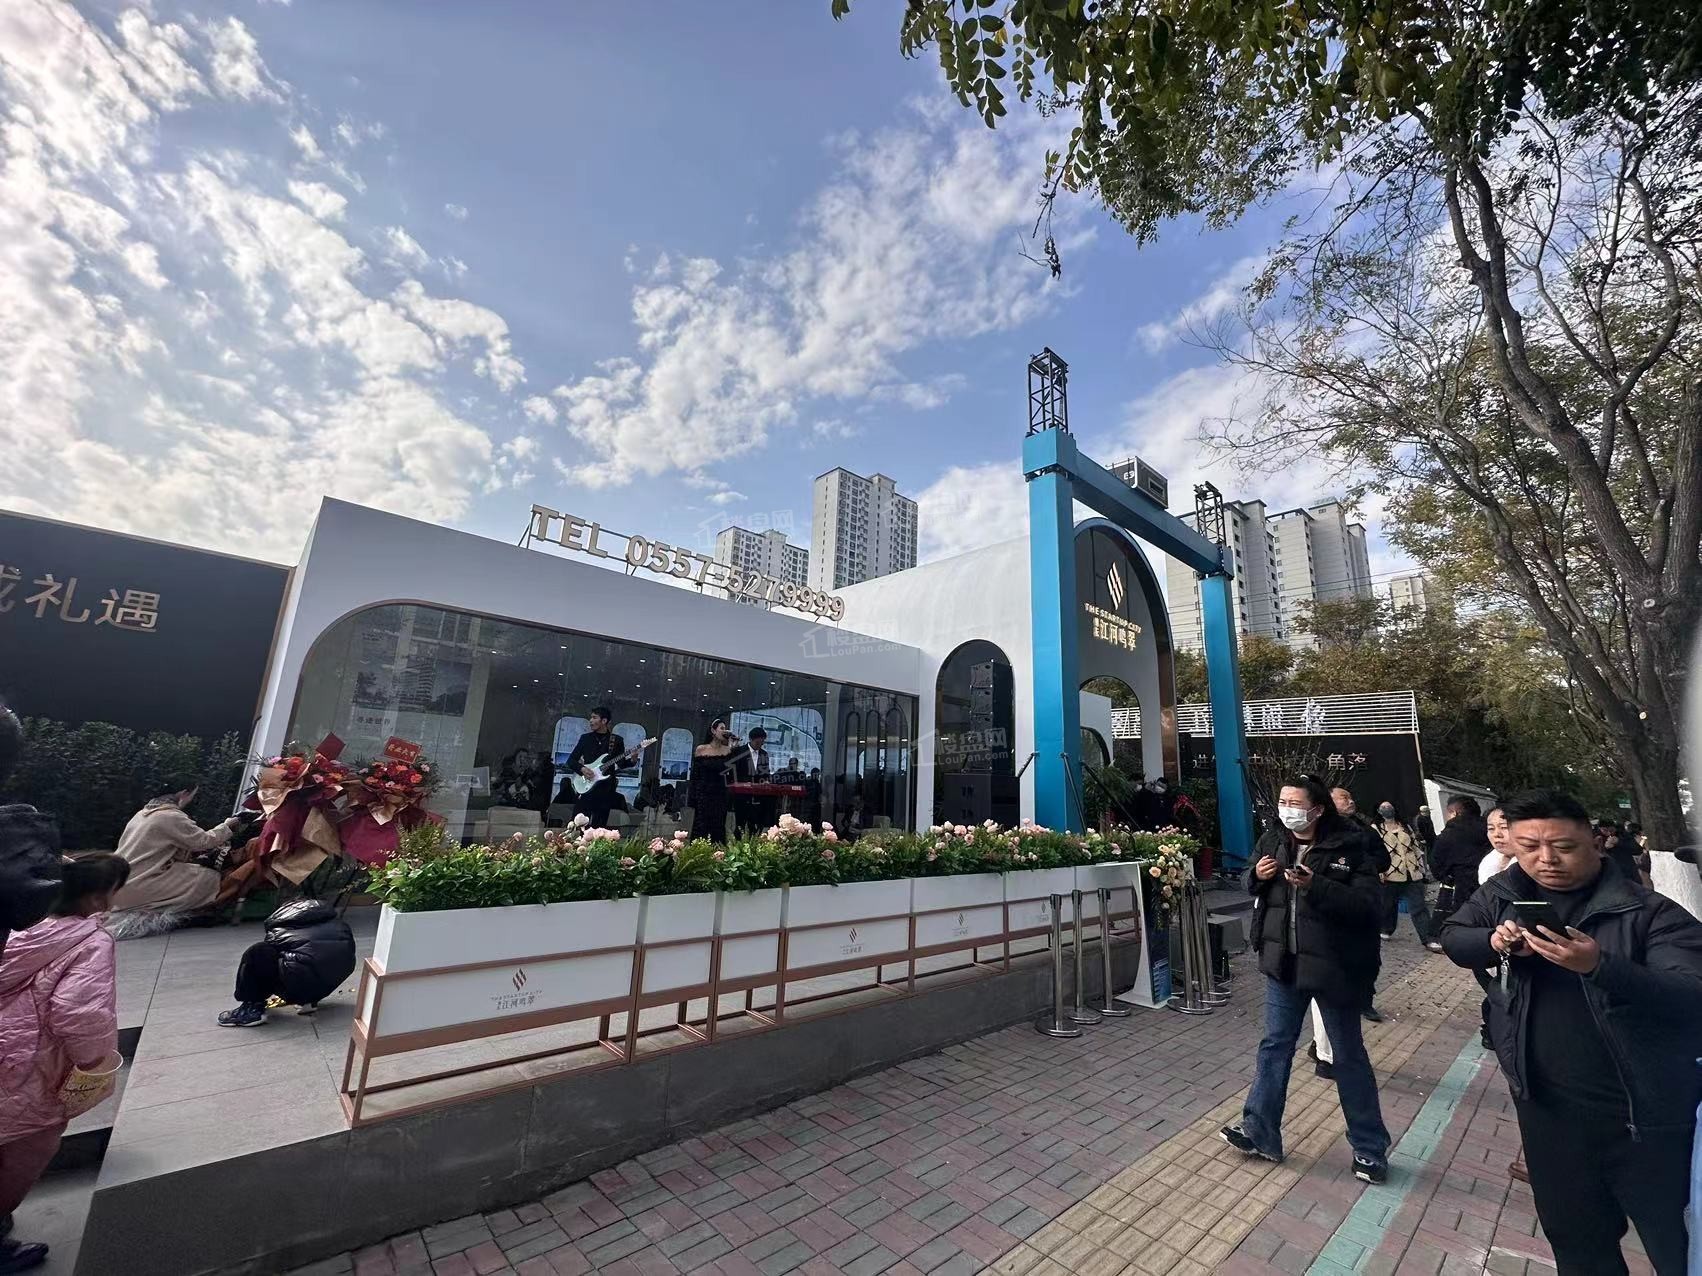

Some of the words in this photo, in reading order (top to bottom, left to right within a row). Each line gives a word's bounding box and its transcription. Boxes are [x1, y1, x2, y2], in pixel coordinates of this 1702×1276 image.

[531, 504, 608, 558] TEL
[626, 534, 845, 623] 0557-5279999
[1084, 602, 1099, 615] THE
